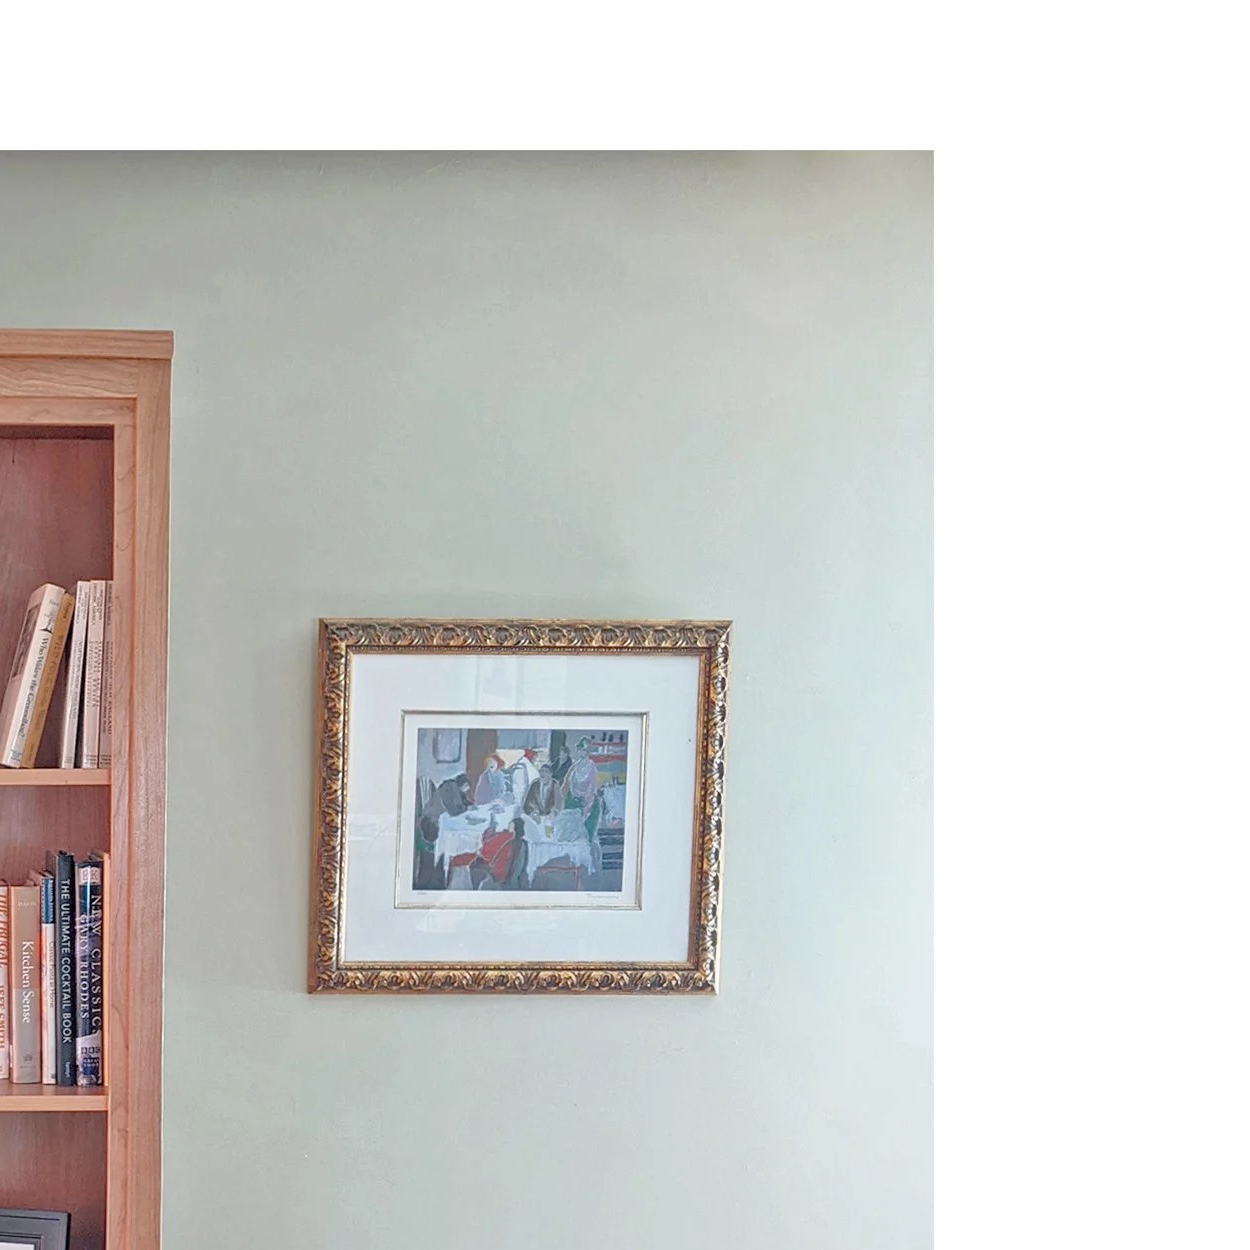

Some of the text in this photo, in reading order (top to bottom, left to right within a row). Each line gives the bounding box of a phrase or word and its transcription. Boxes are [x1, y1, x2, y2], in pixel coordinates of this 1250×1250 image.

[39, 637, 50, 655] Who
[29, 679, 40, 692] the
[32, 656, 44, 679] Wakes
[91, 895, 102, 936] NEW
[61, 880, 72, 1043] THE ULTIMATE COCKTAIL BOOK
[80, 914, 90, 1019] GARY RHODES
[22, 941, 35, 1024] Kitchen Sense
